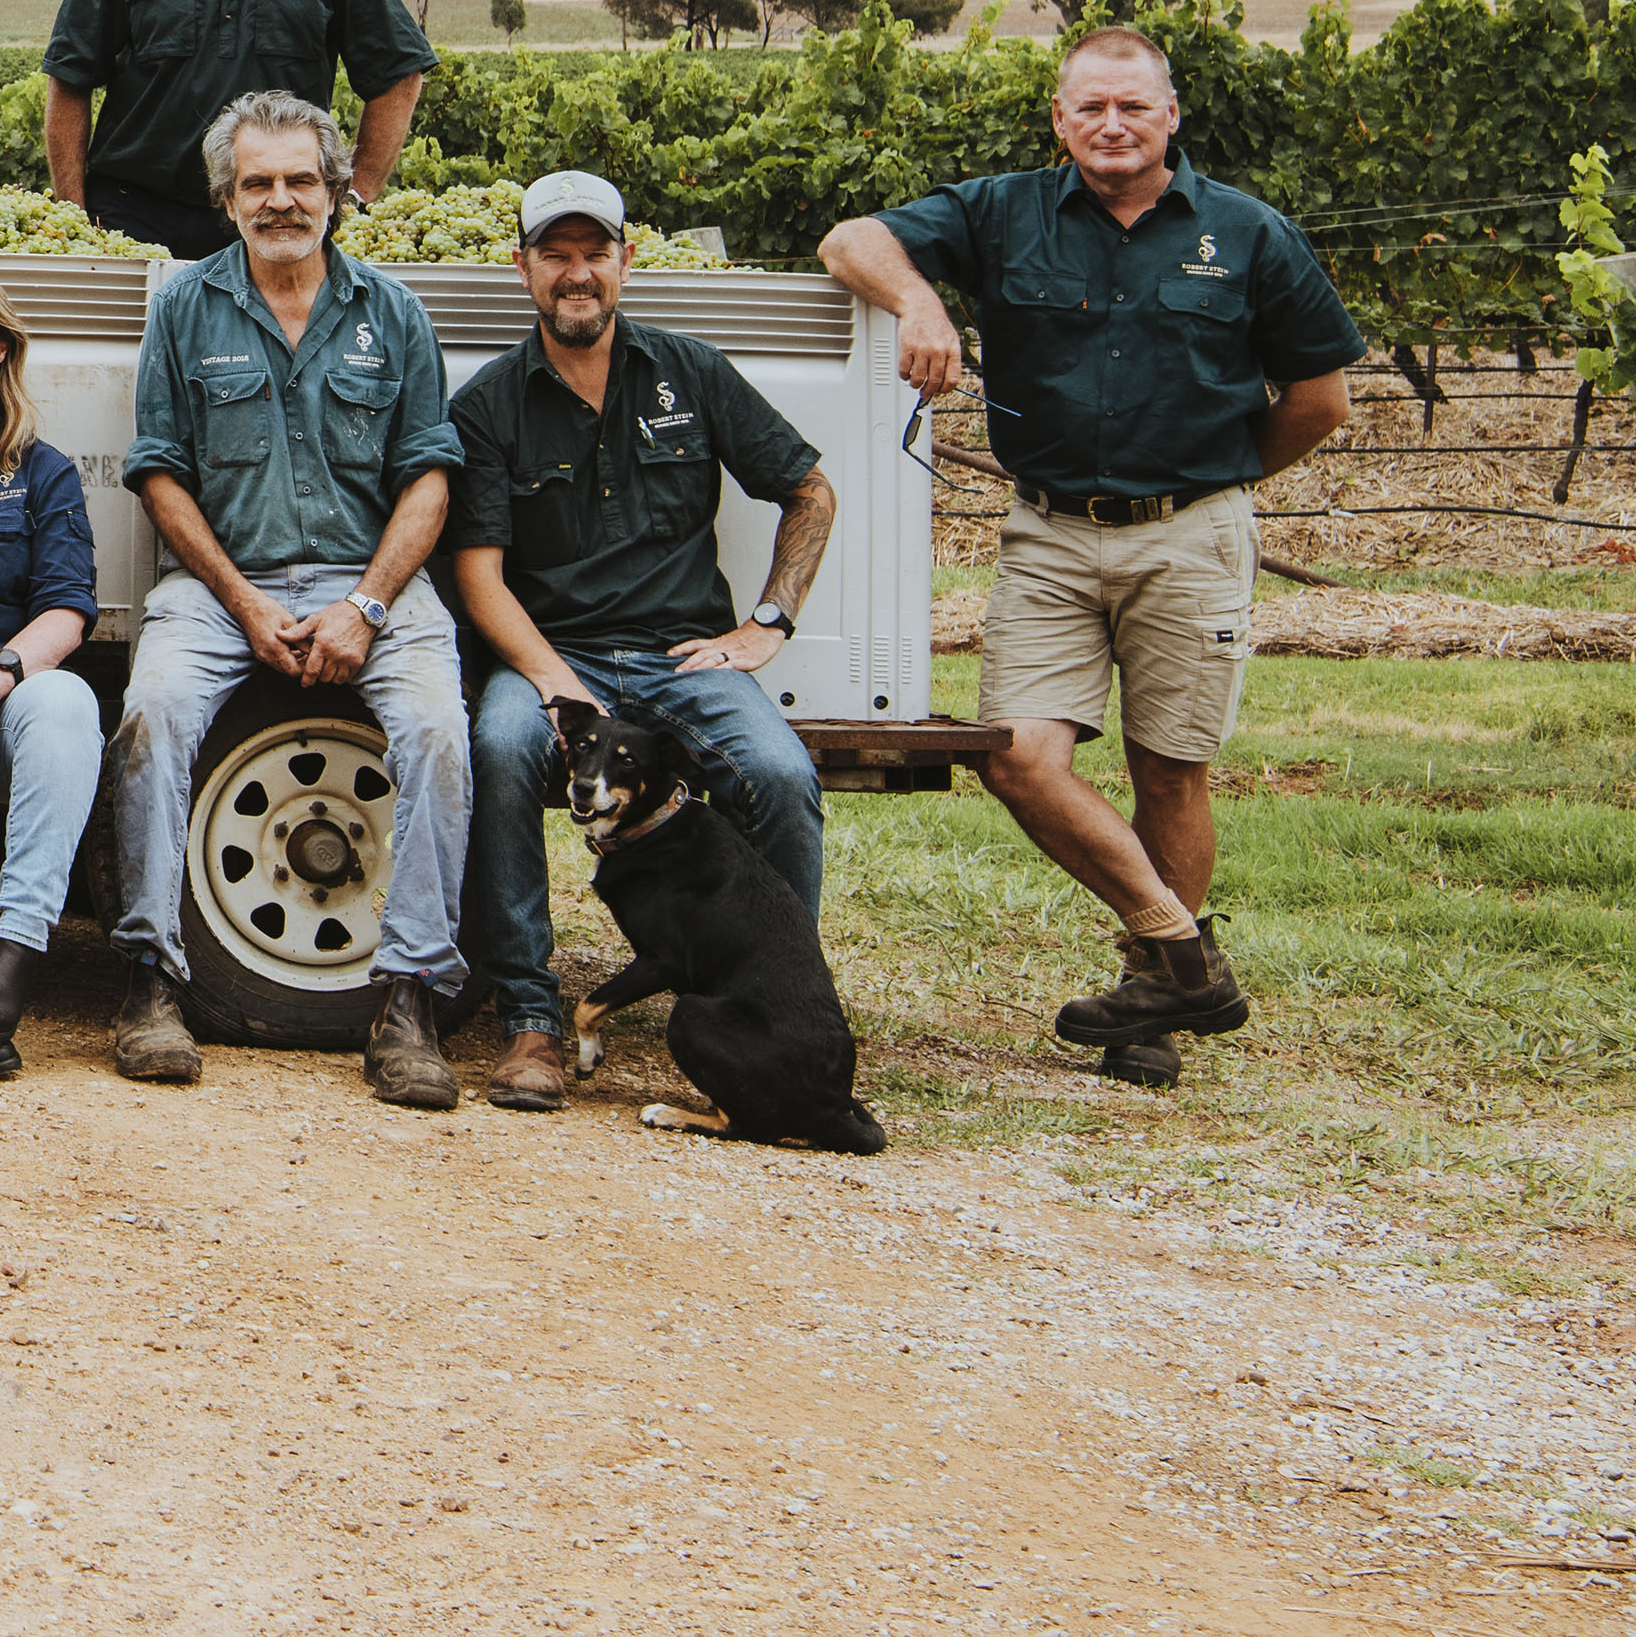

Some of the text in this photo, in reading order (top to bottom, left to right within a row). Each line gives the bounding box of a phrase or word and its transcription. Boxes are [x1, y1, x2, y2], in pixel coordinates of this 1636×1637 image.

[1181, 263, 1209, 271] ROBERT
[1209, 266, 1229, 275] STEIN
[648, 415, 673, 425] ROBERT
[674, 412, 694, 420] STEIN
